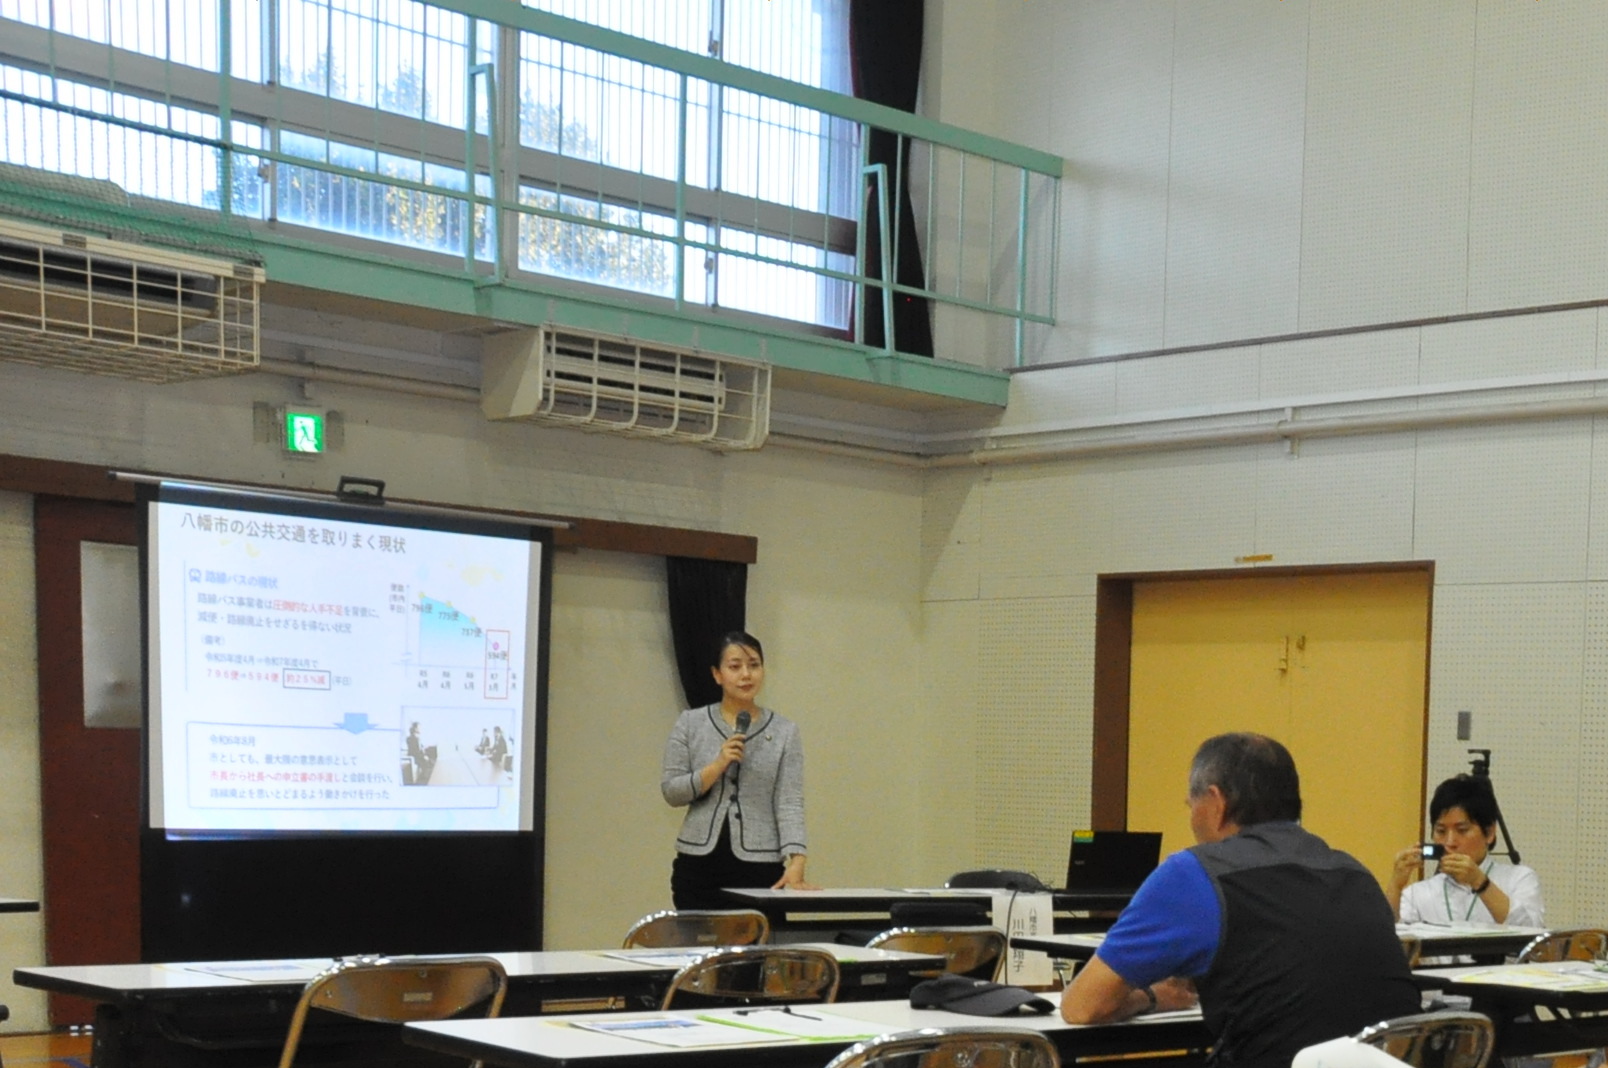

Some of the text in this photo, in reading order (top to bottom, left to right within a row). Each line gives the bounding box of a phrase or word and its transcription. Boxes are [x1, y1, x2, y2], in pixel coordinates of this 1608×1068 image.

[180, 512, 407, 554] 八幡市の公共交通を取りまく現状
